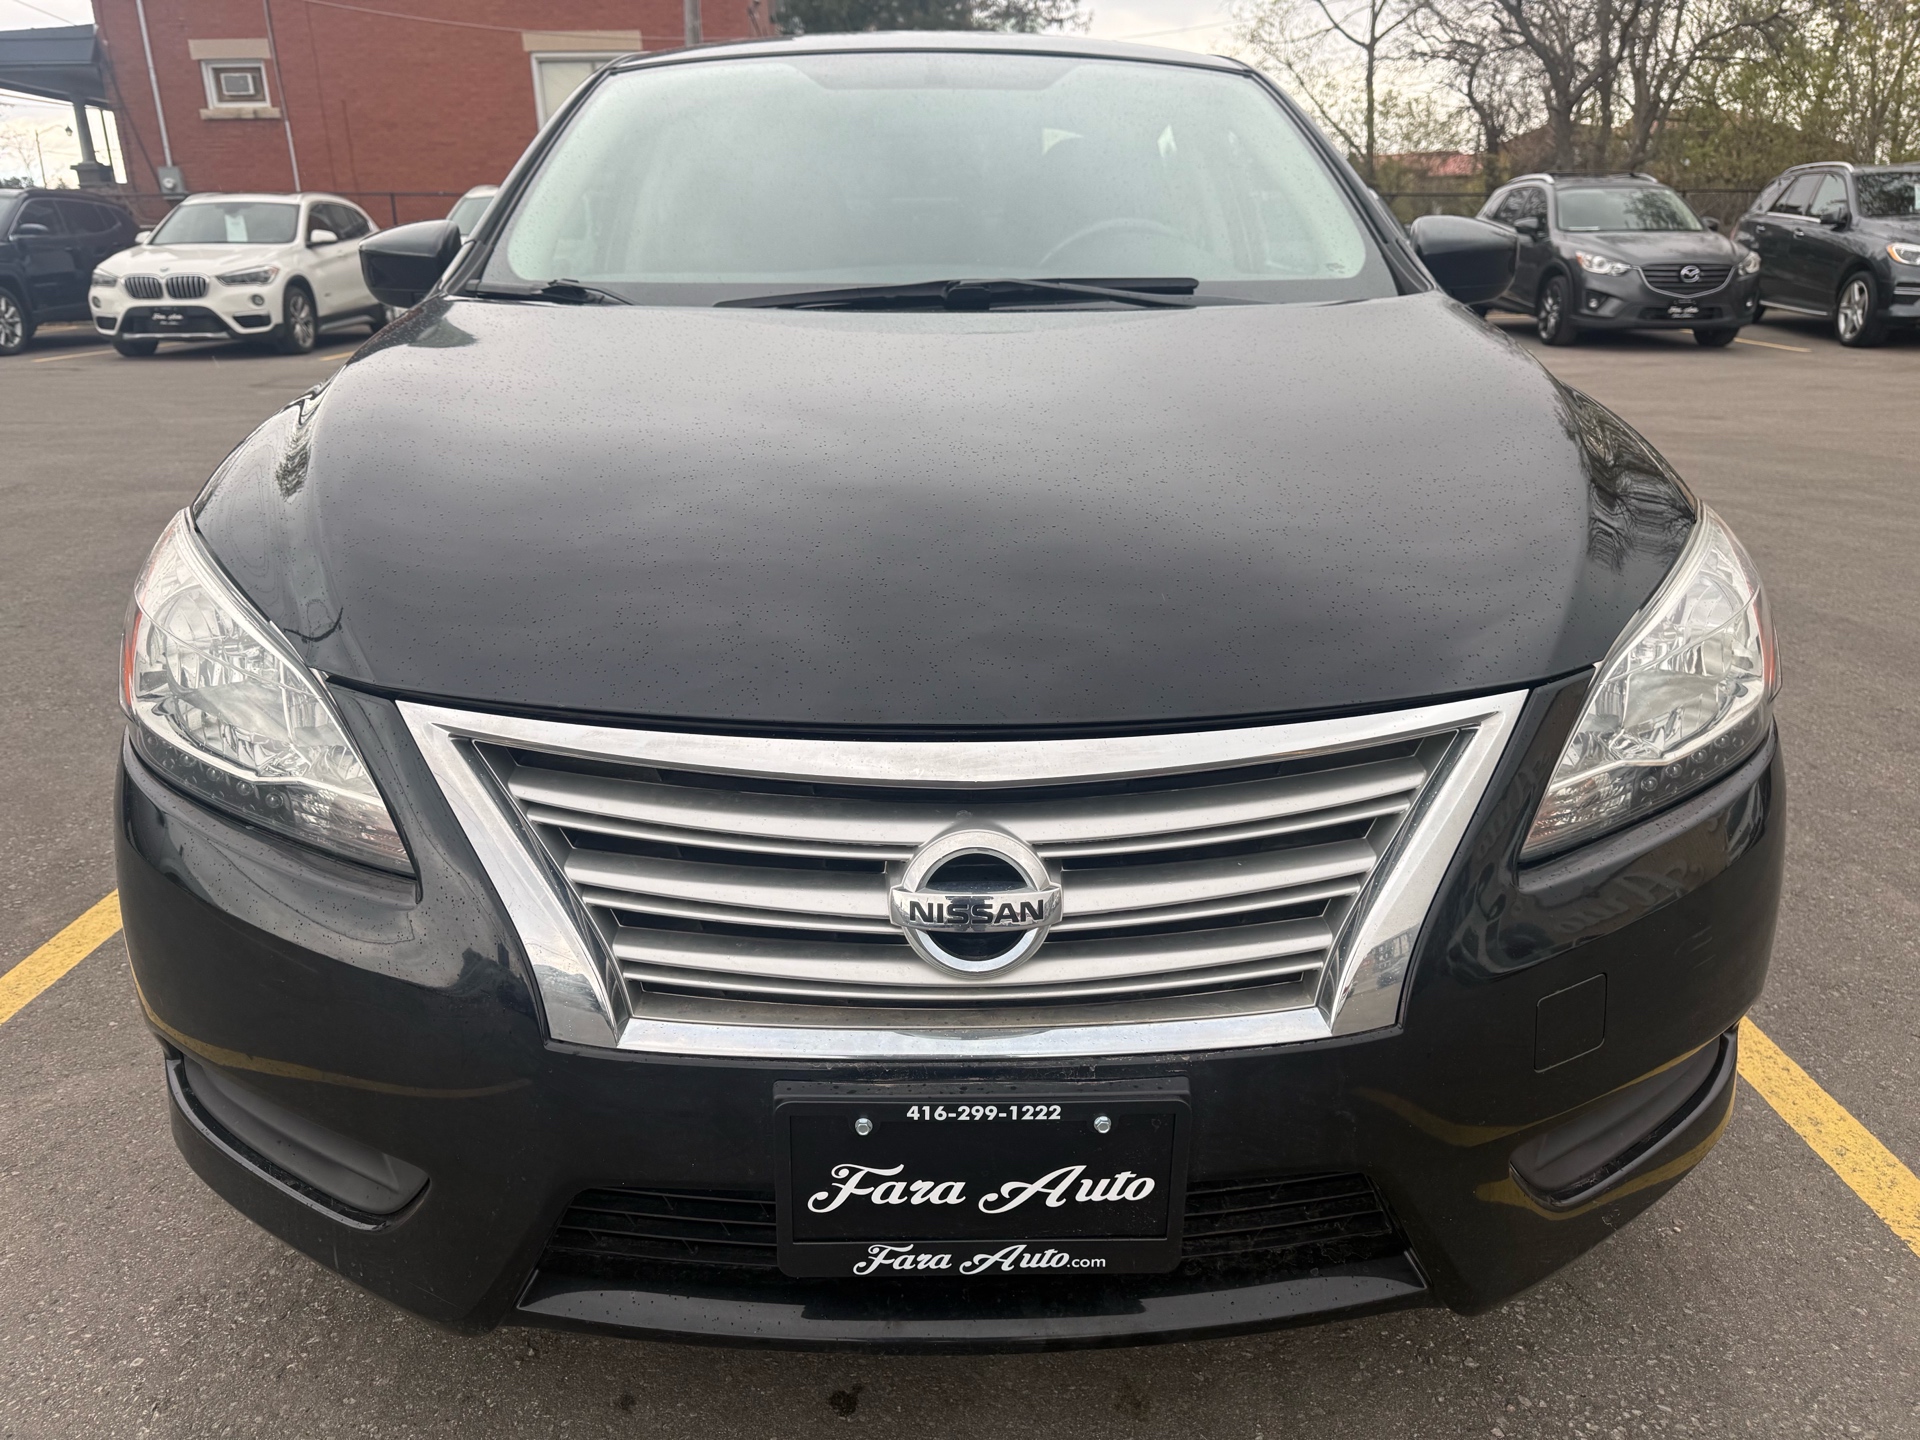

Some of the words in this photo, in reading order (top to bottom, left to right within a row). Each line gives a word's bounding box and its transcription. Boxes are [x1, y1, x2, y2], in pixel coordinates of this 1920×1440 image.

[908, 899, 1044, 925] NISSAN
[906, 1104, 1062, 1121] 416-299-1222
[807, 1163, 967, 1214] Fara
[978, 1164, 1156, 1214] Auto
[852, 1243, 953, 1276] Fara
[958, 1244, 1106, 1276] Auto.com
